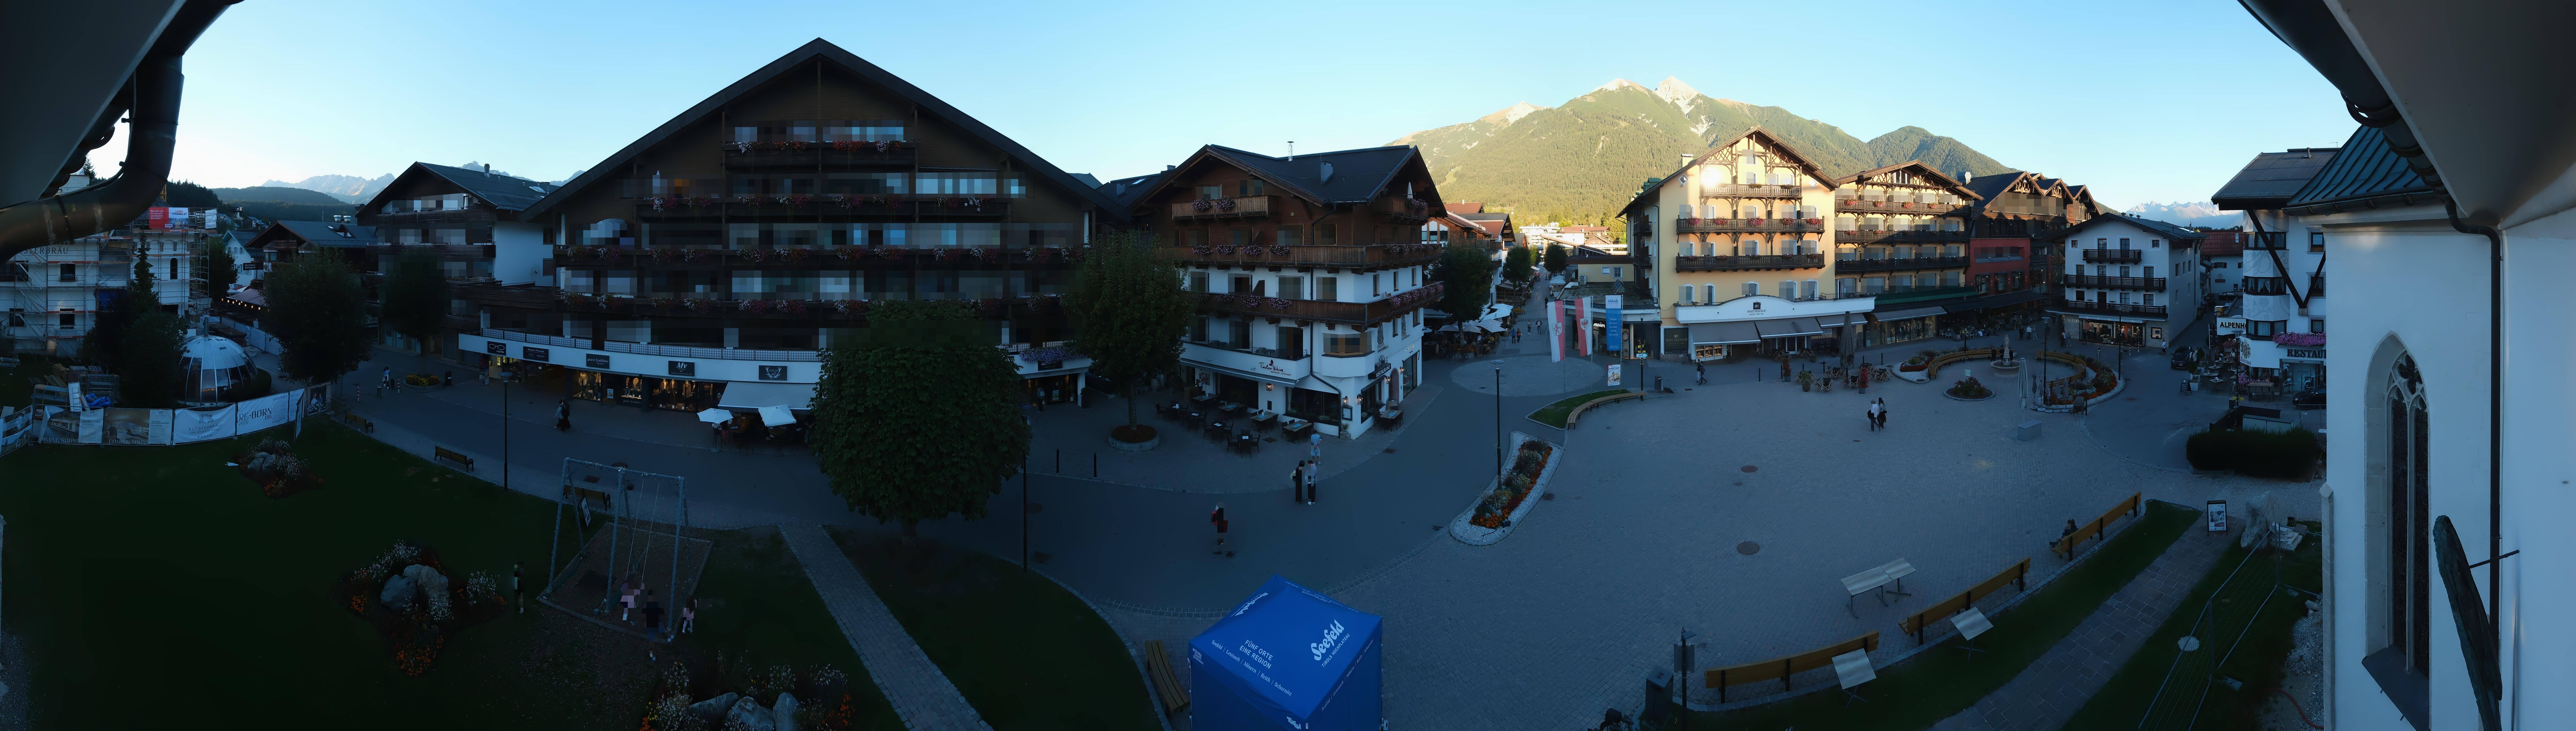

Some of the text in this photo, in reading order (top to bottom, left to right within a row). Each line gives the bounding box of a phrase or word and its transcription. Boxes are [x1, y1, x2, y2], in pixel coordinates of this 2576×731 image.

[1376, 365, 1390, 378] RESTAURANT
[1245, 639, 1273, 661] FÜNF ORTE
[1311, 619, 1344, 661] Seefeld
[1321, 633, 1350, 667] TIROLS HOCHPLATEAU
[1192, 648, 1202, 657] #tirols
[1193, 655, 1203, 665] plateau
[1239, 645, 1272, 669] EINE REGION
[1211, 640, 1292, 696] Seefeld Leutasch Mösern Reith Scharnitz
[1286, 716, 1301, 729] Tirol
